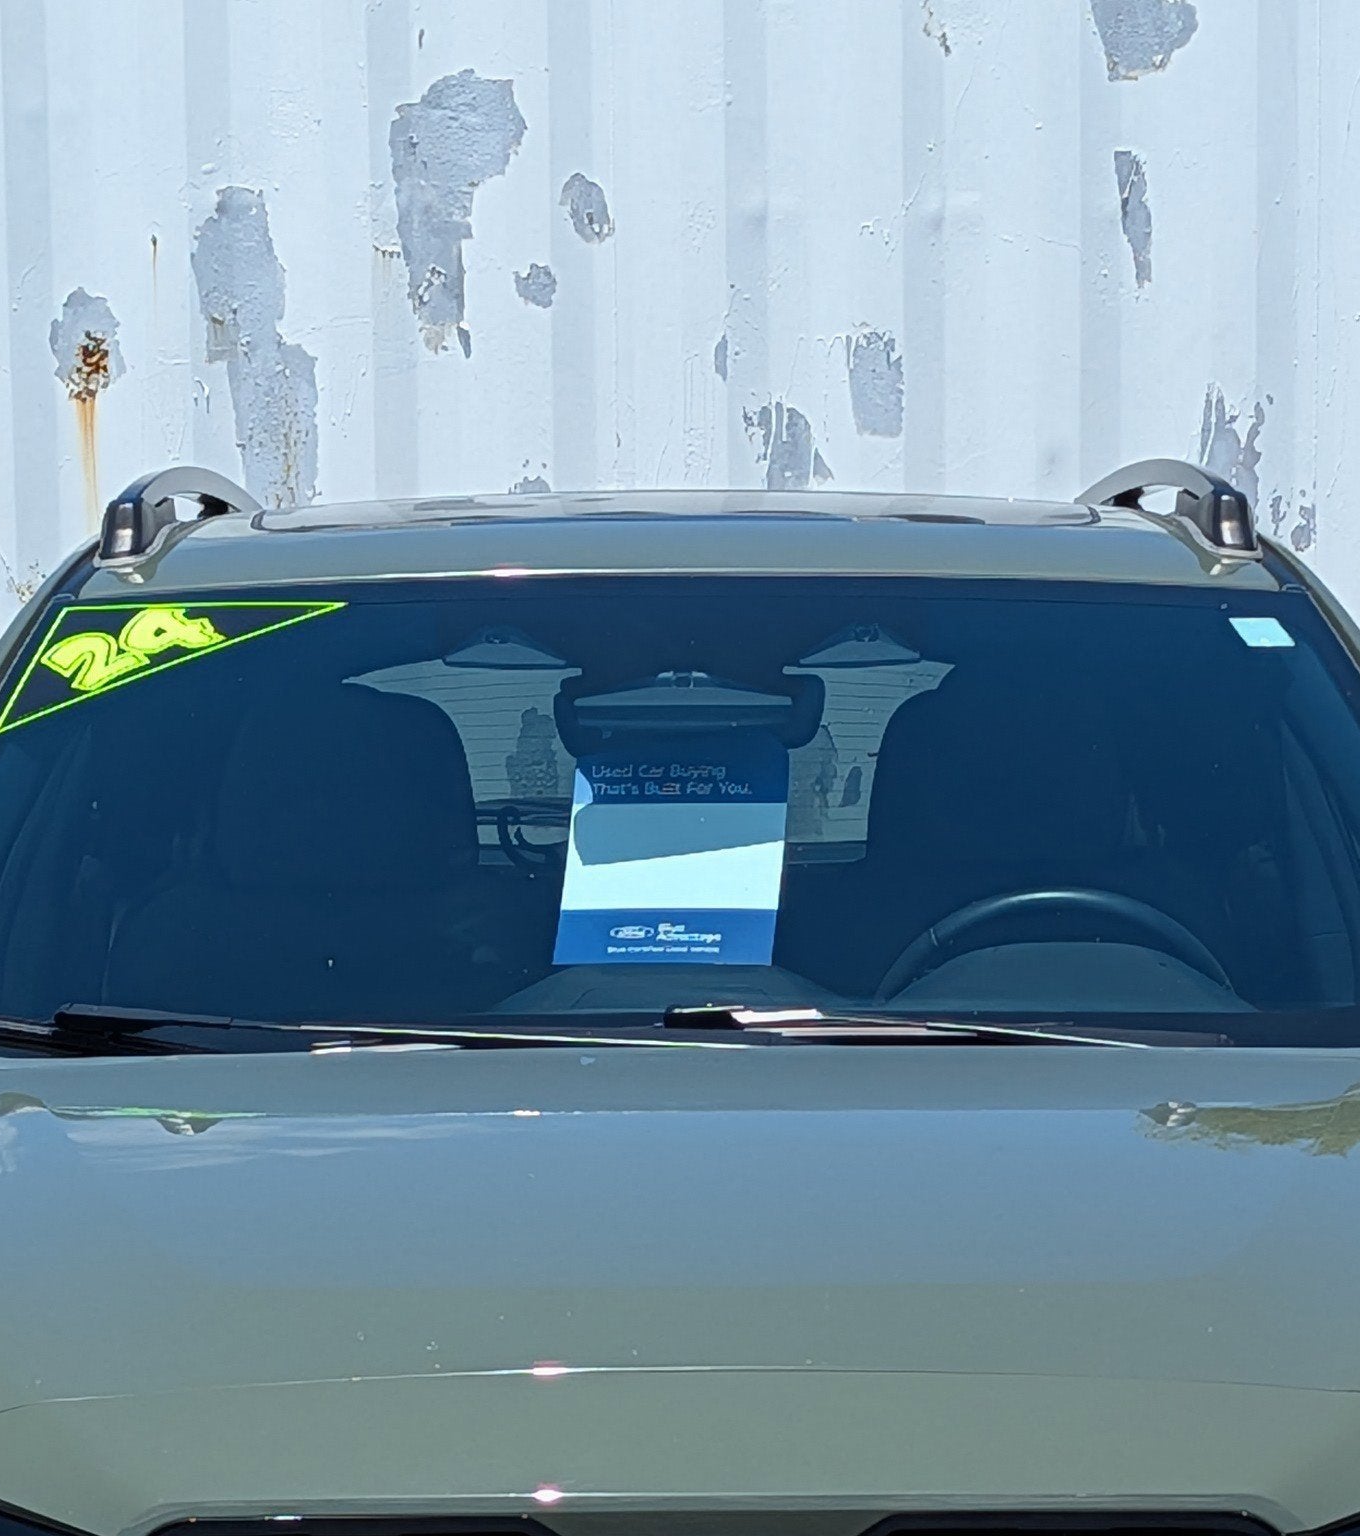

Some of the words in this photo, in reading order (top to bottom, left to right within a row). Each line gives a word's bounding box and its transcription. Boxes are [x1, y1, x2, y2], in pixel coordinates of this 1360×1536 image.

[41, 607, 227, 691] 24
[592, 764, 632, 777] Used
[638, 765, 665, 777] Car
[670, 764, 726, 780] Buying
[593, 783, 639, 795] That's
[686, 783, 713, 795] For
[719, 783, 752, 795] You.
